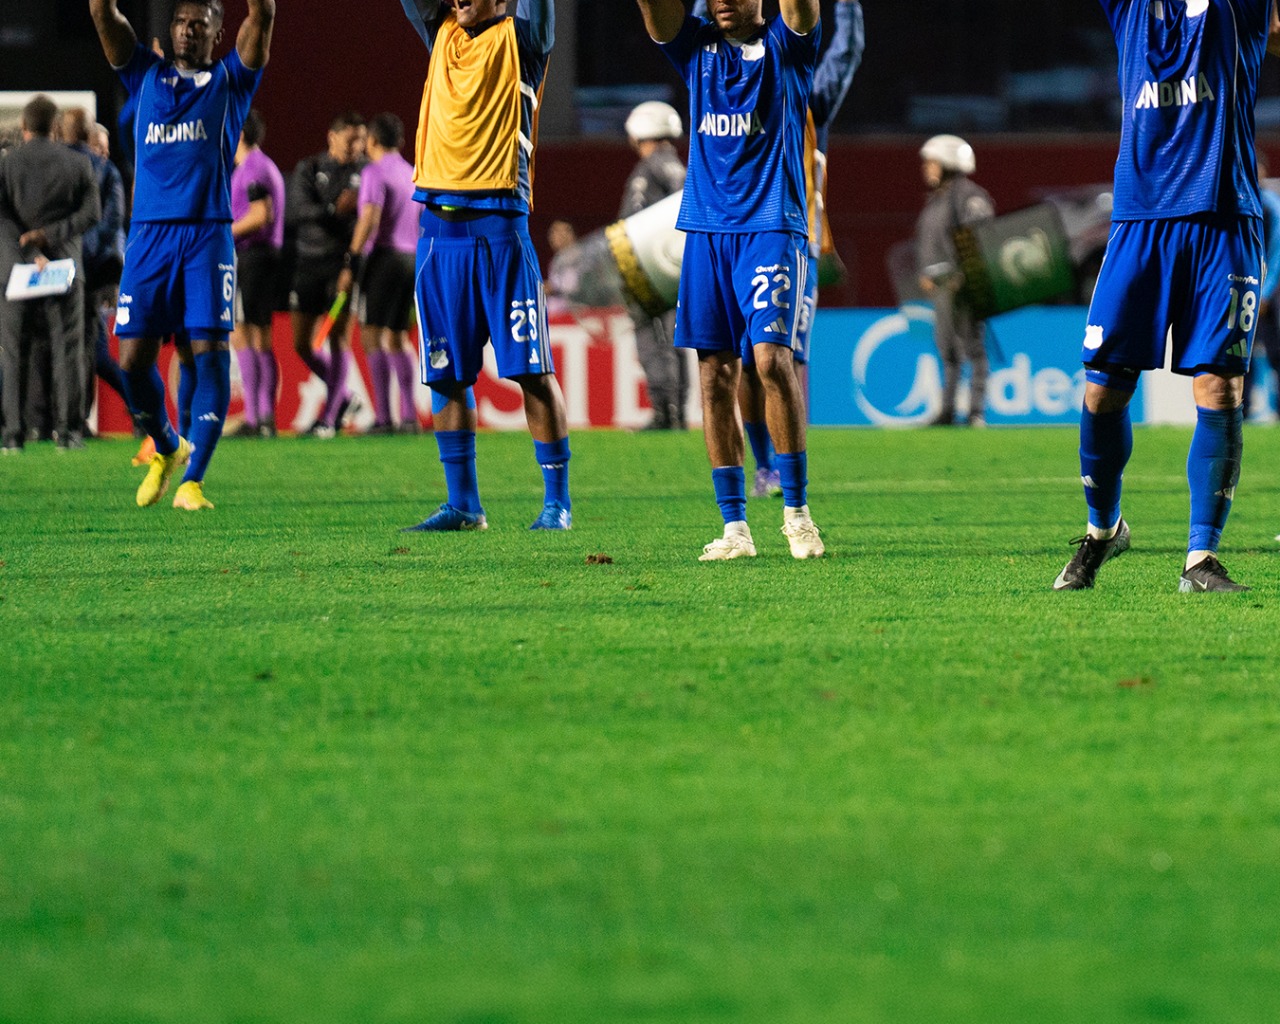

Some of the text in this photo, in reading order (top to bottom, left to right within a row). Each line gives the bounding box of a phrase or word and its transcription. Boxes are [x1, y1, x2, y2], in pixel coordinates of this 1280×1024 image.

[1135, 72, 1215, 109] ANDINA
[145, 118, 208, 144] ANDINA
[697, 109, 766, 137] ANDINA
[222, 272, 233, 302] 6
[751, 274, 791, 309] 22
[1227, 287, 1257, 332] 18
